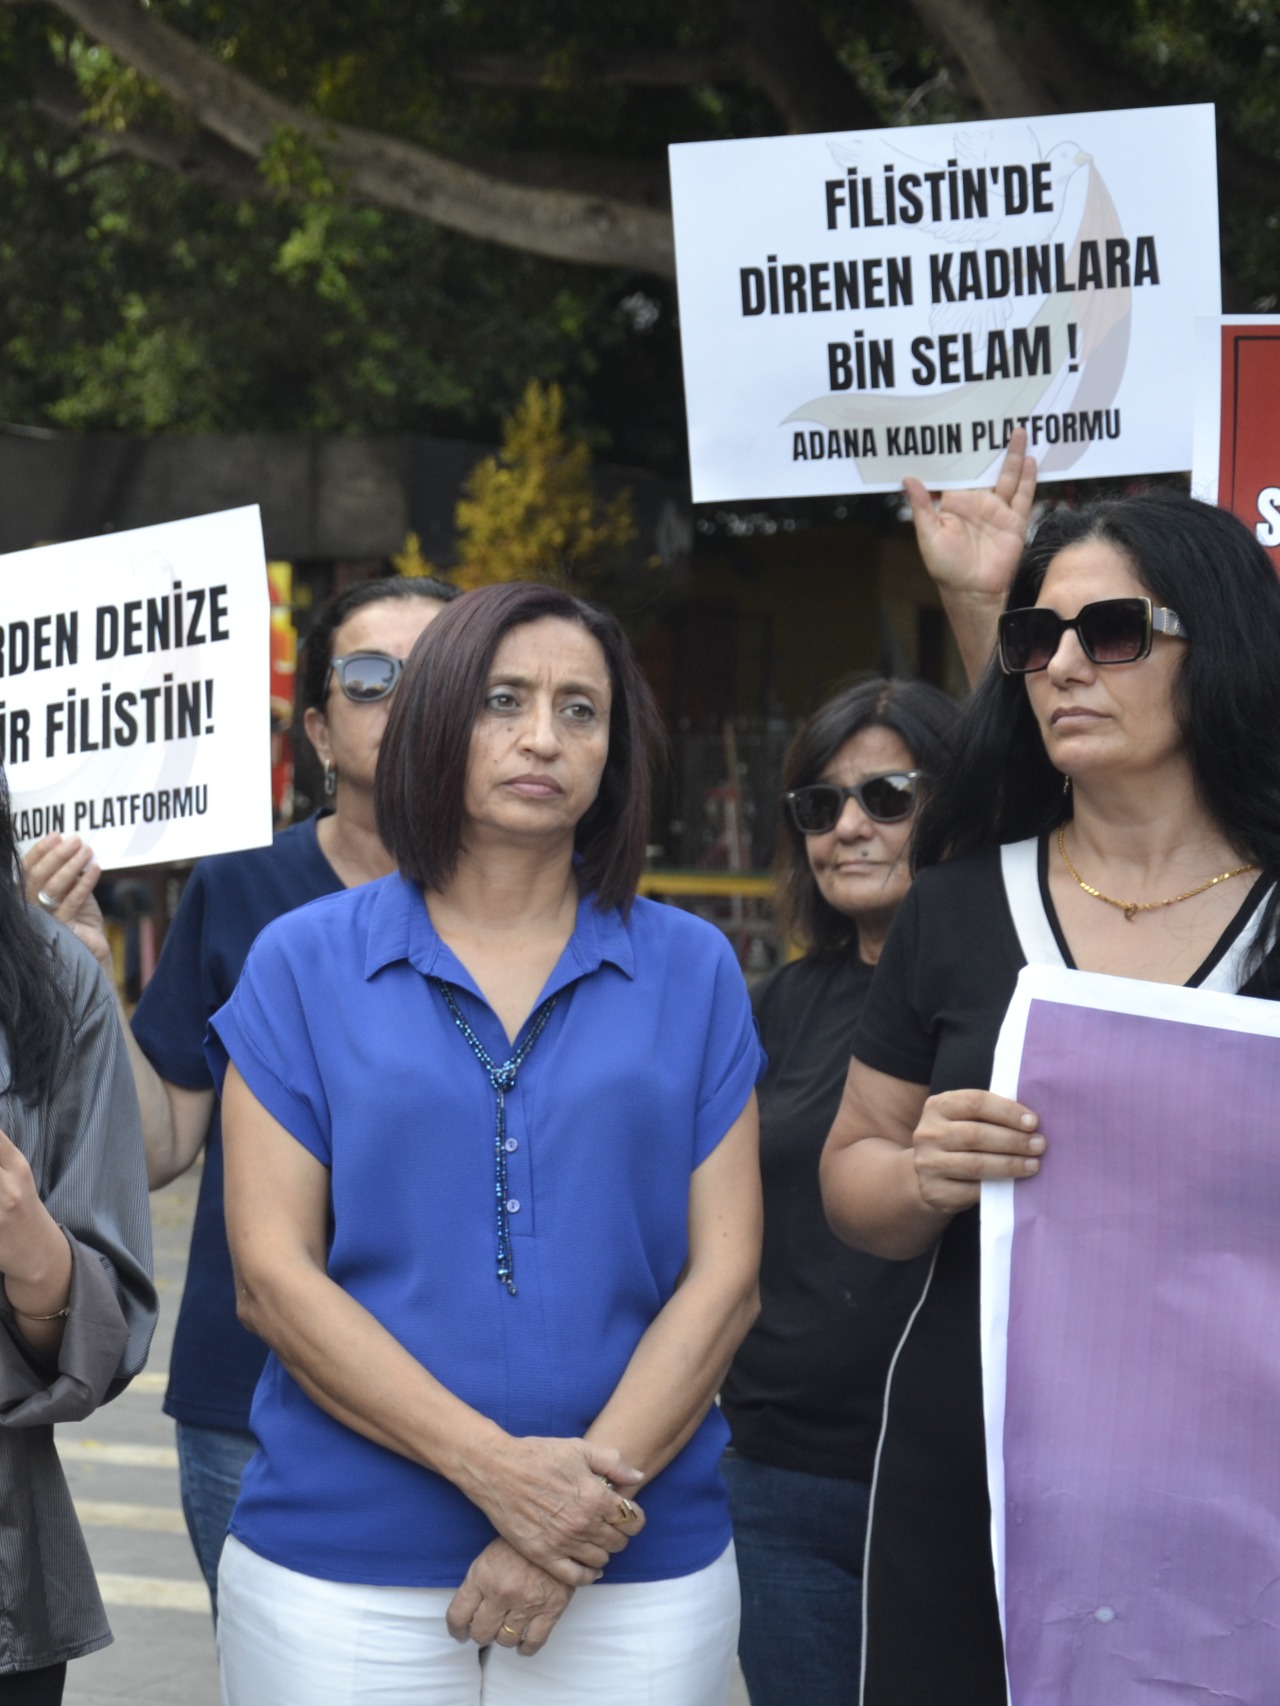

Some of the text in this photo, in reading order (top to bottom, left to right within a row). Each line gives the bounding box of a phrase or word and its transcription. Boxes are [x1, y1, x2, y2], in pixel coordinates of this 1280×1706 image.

[824, 158, 1054, 230] FİLİSTİN'DE
[739, 235, 1160, 317] DİRENEN KADINLARA
[826, 329, 895, 391] BİN
[910, 325, 1052, 387] SELAM
[792, 408, 1121, 461] ADANA KADIN PLATFORMU
[95, 580, 231, 661] DENİZE
[45, 672, 215, 758] FİLİSTİN!
[74, 784, 209, 832] PLATFORMU
